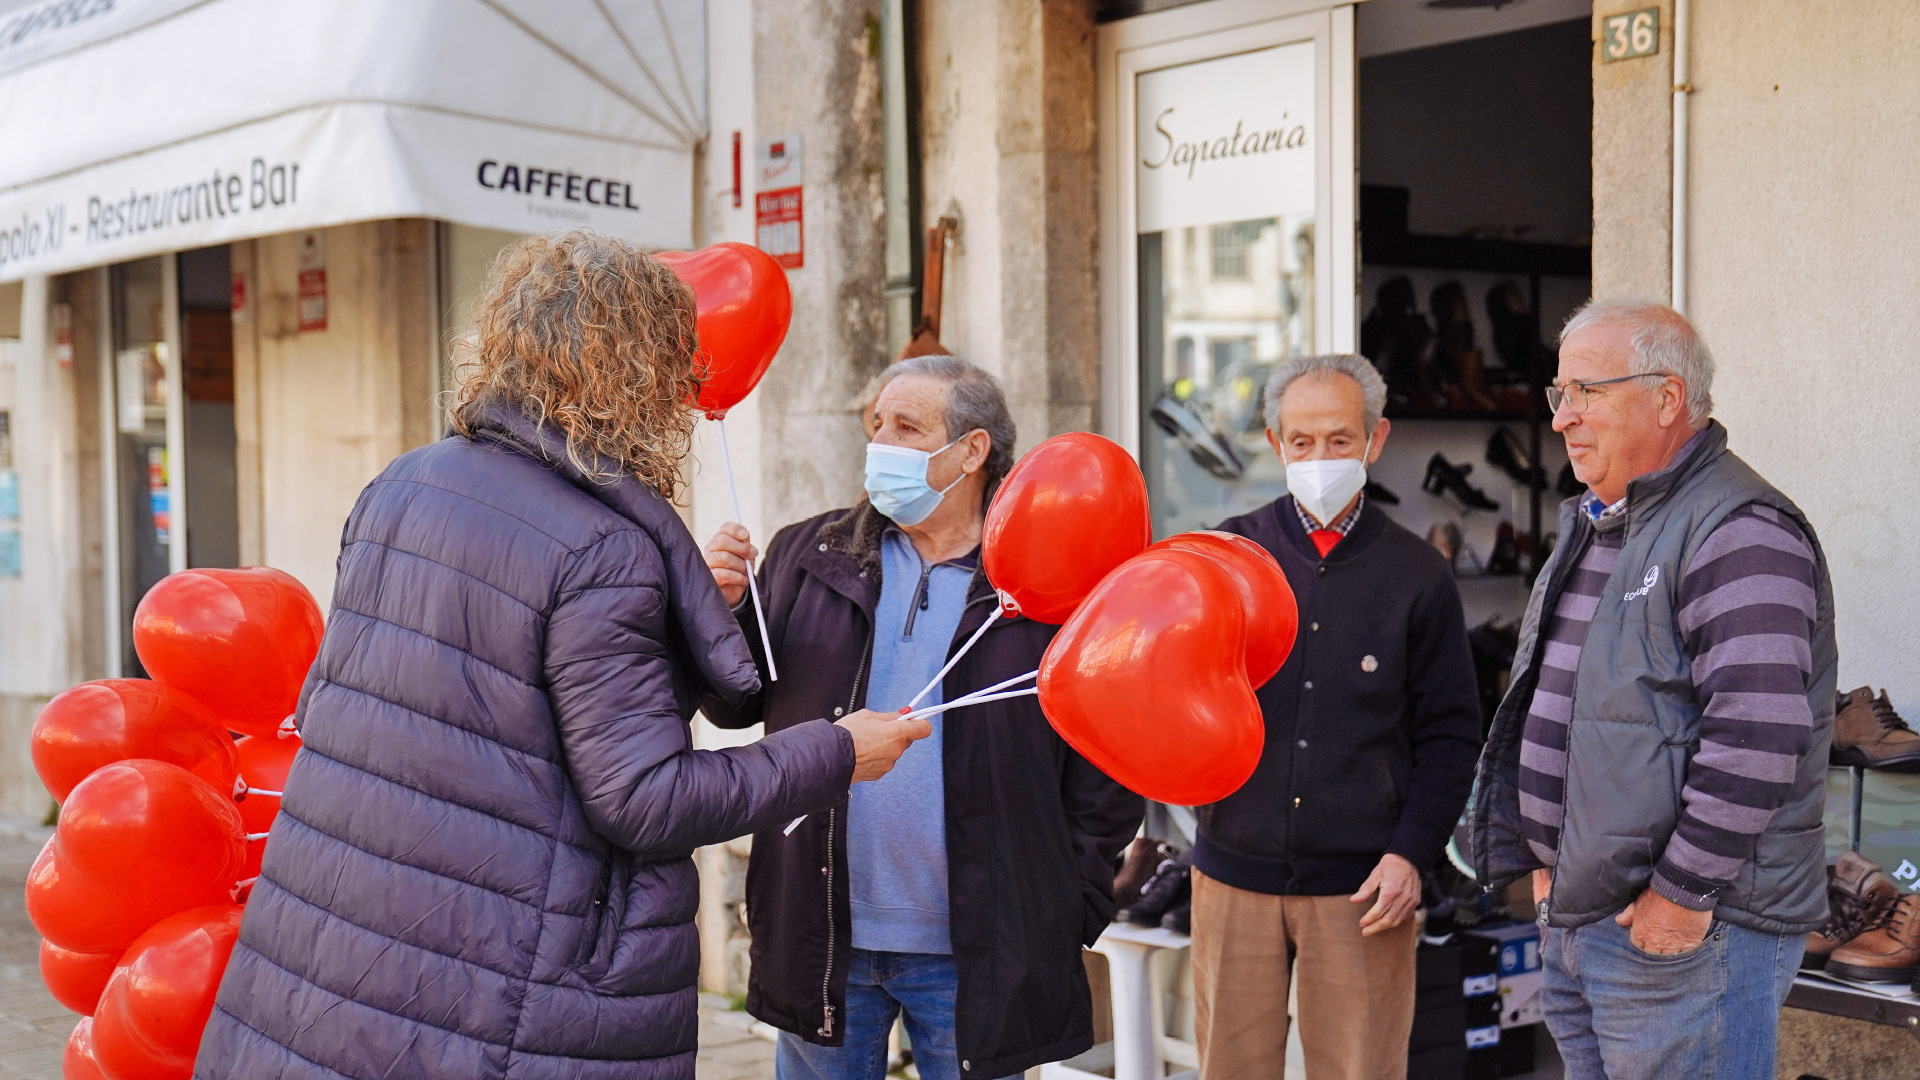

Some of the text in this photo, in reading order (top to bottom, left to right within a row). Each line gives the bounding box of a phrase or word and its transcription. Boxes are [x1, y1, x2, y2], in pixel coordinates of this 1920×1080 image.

[1608, 13, 1653, 58] 36
[1142, 107, 1309, 180] Sapataria
[86, 170, 242, 243] Restaurante
[250, 157, 299, 209] Bar
